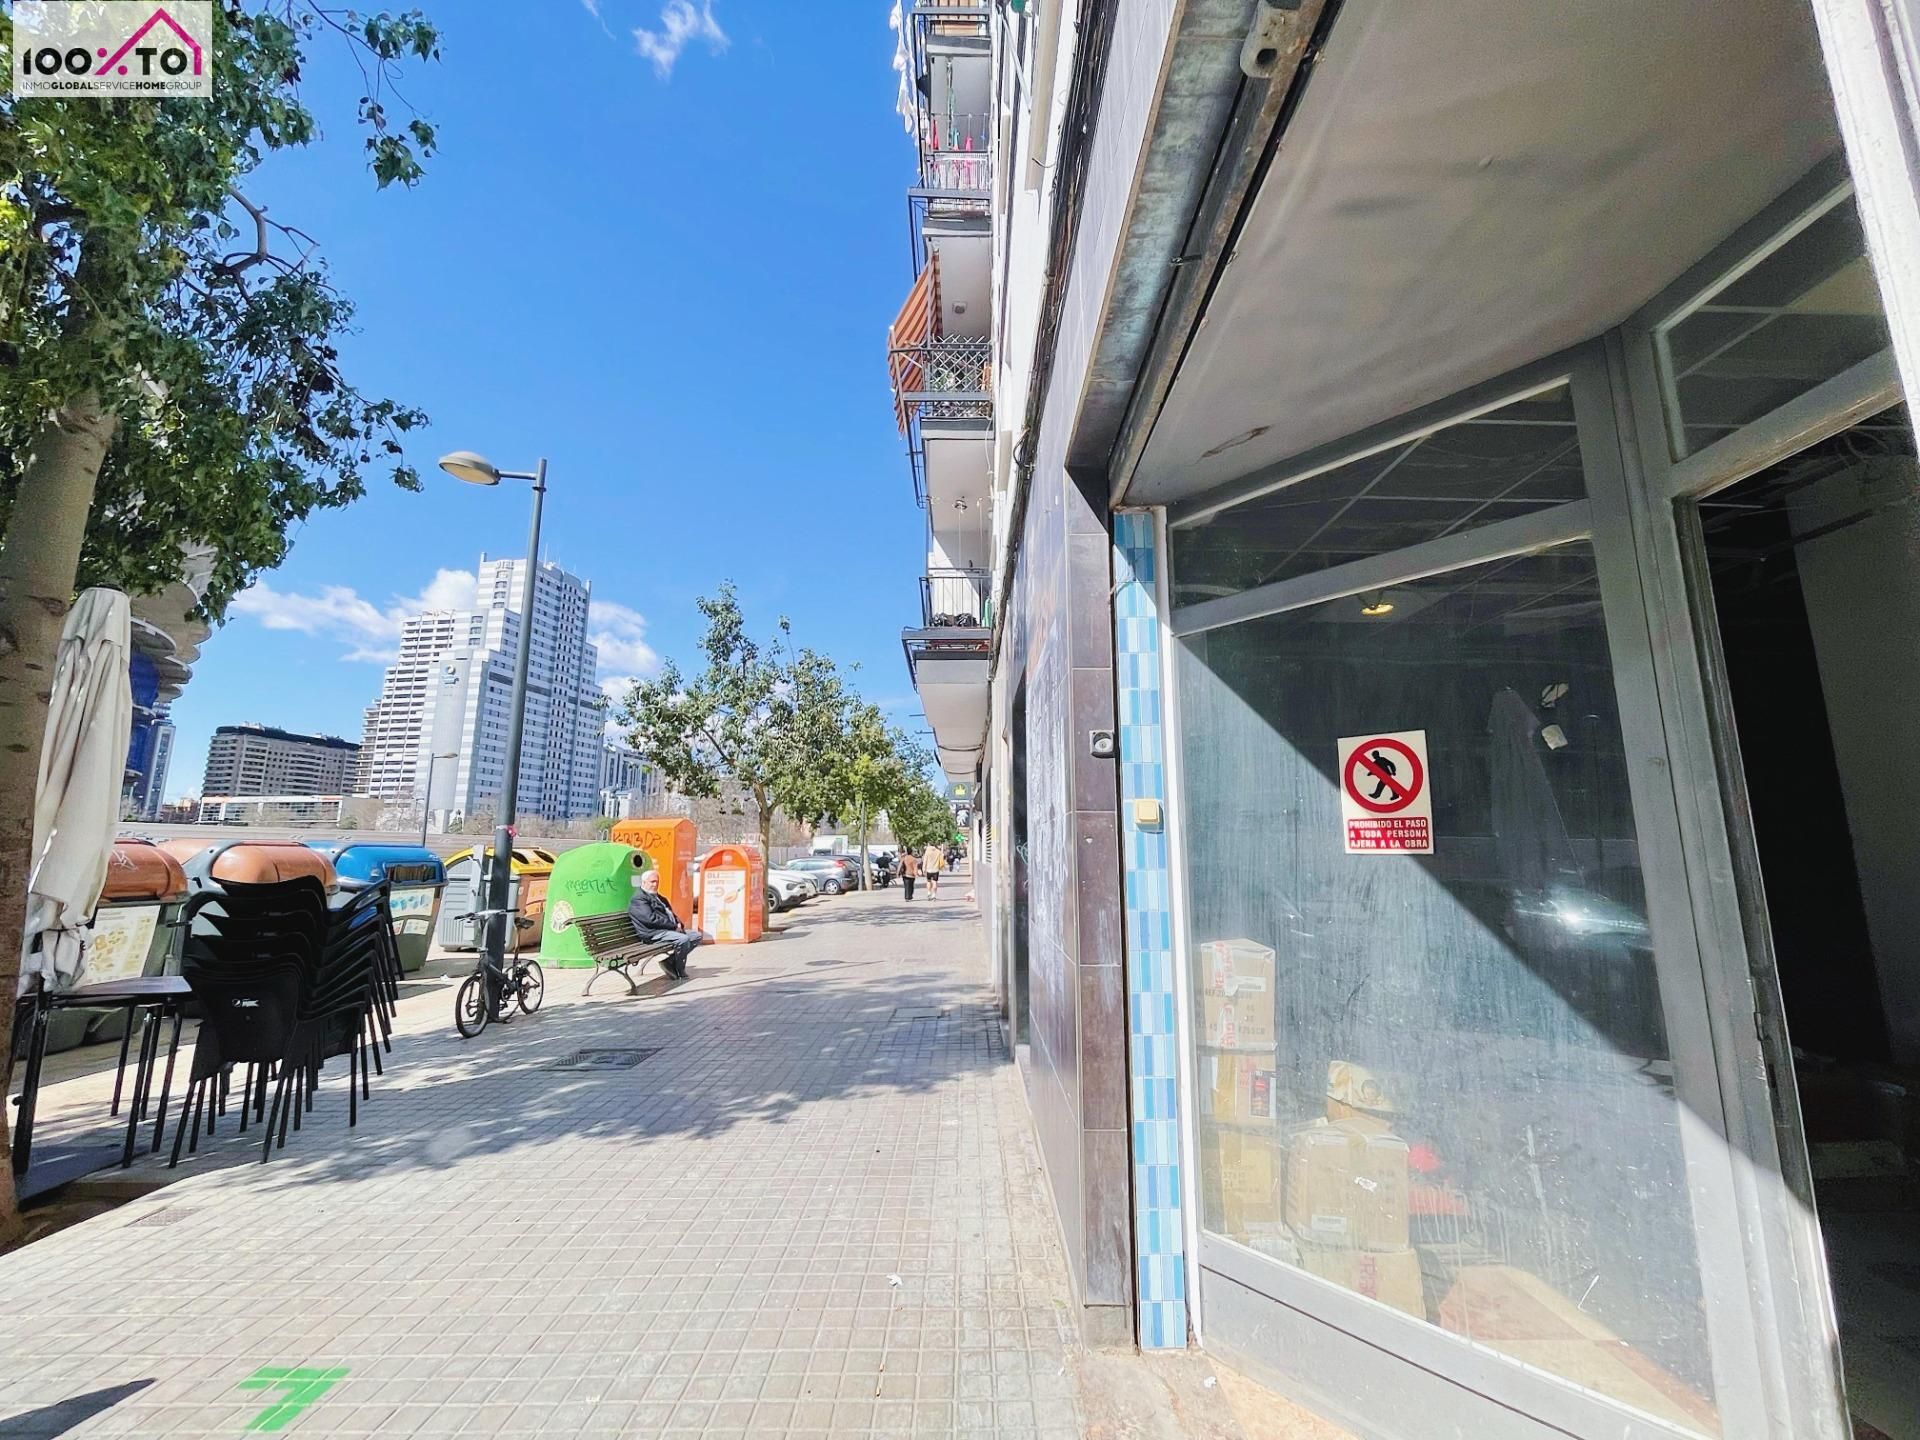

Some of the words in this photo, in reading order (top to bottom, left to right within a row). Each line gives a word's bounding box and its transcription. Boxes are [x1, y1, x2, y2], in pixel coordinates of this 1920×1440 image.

[1350, 820, 1392, 829] PROHIBIDO
[1394, 820, 1403, 828] EL
[1406, 819, 1427, 828] PASO
[1350, 830, 1356, 838] A
[1360, 830, 1382, 838] TODA
[1387, 829, 1427, 838] PERSONA
[1350, 840, 1377, 848] AJENA
[1380, 840, 1386, 848] A
[1390, 840, 1401, 848] LA
[1405, 839, 1428, 848] OBRA
